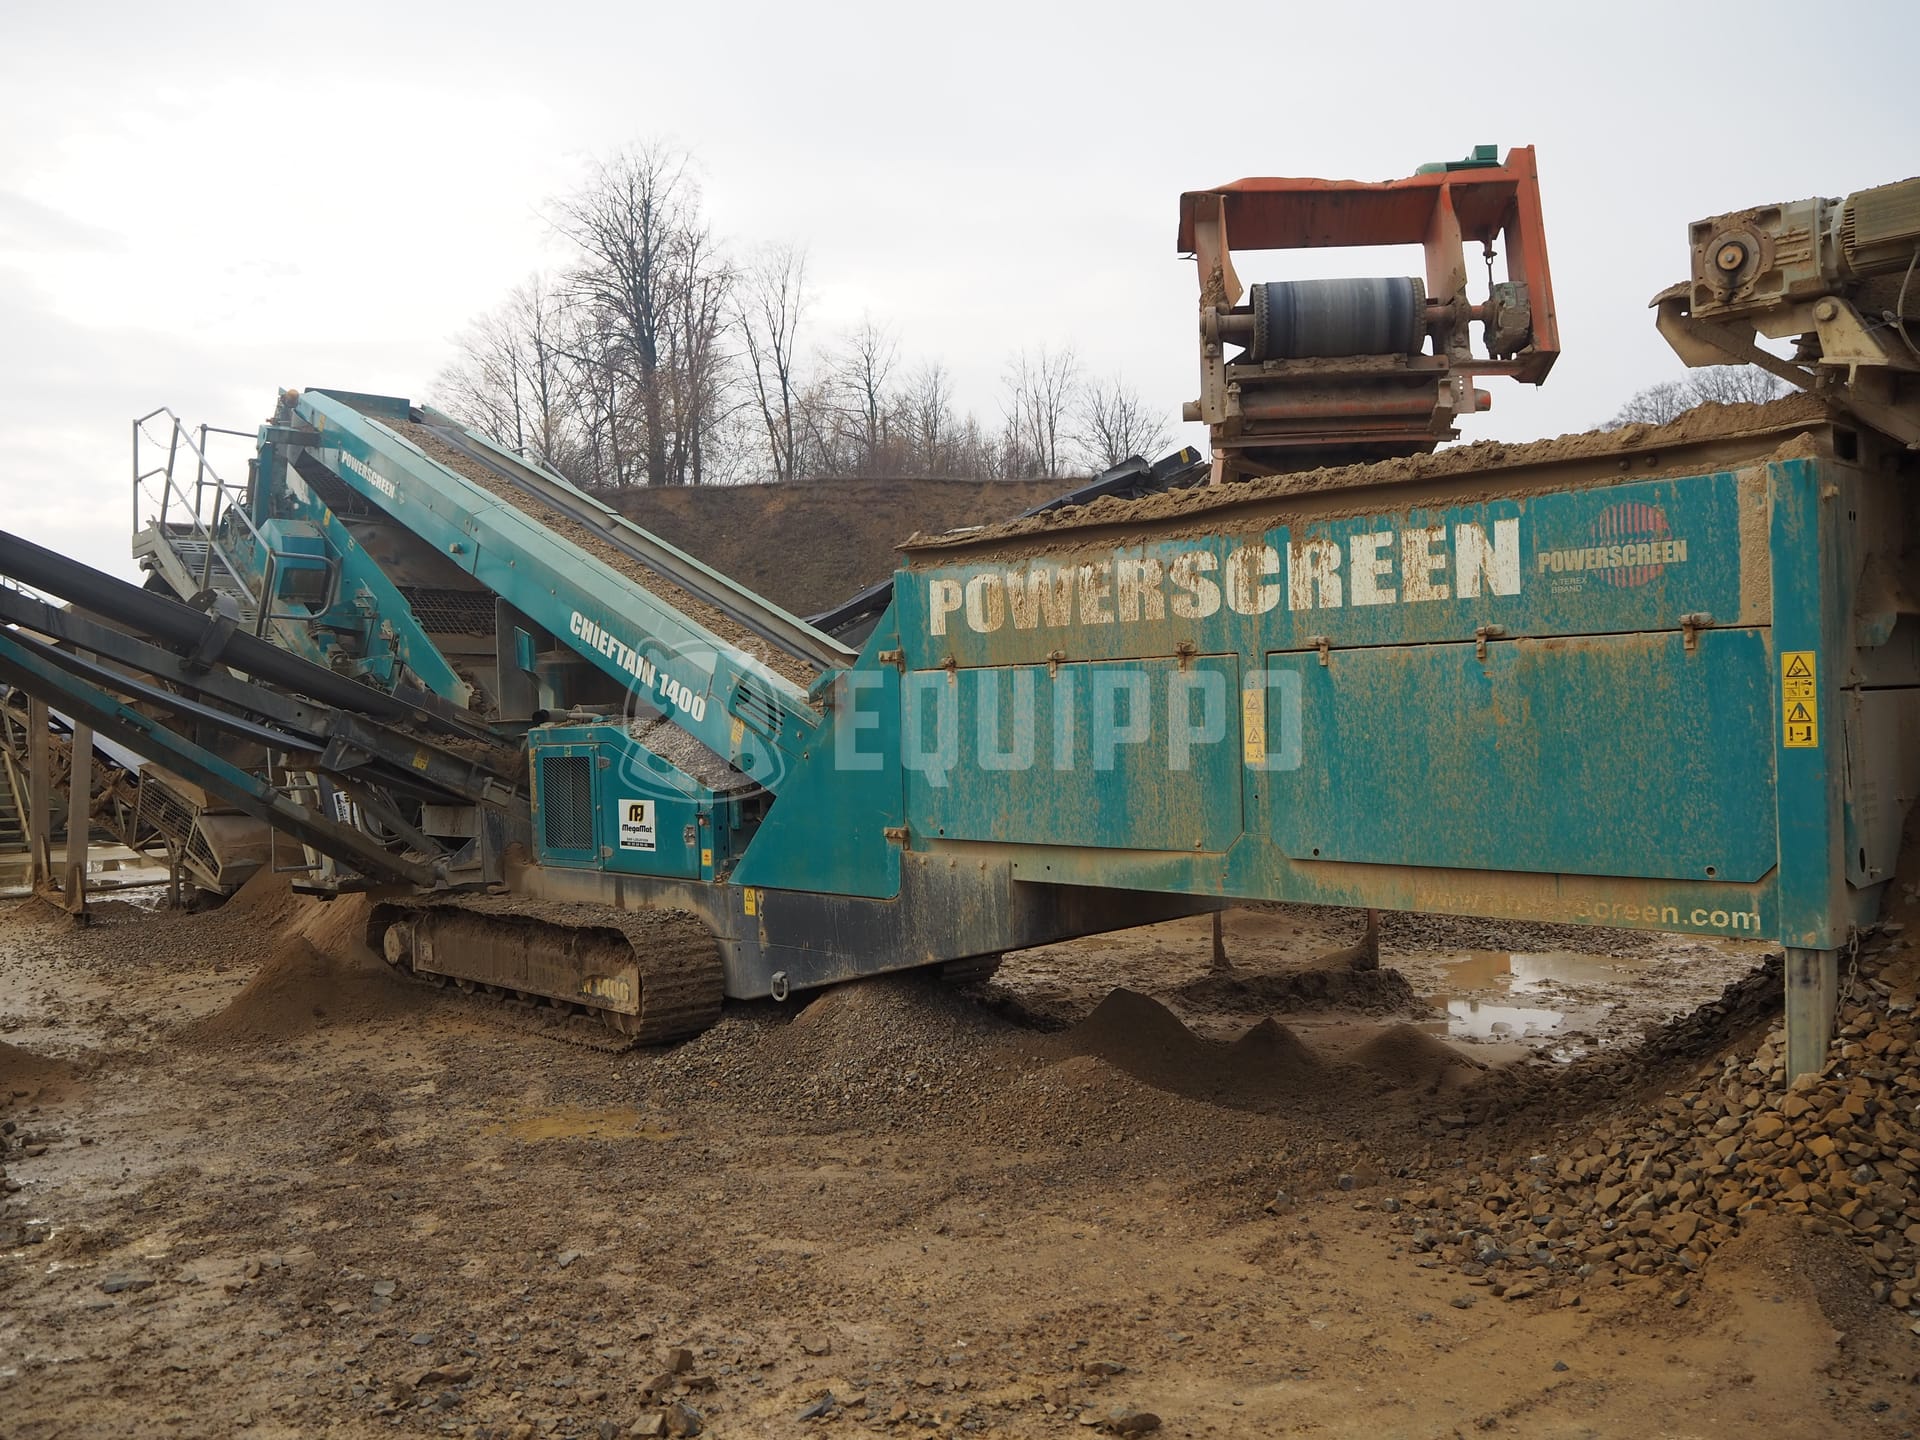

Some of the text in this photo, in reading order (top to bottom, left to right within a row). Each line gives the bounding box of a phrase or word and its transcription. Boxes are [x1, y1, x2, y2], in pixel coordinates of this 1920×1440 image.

[341, 450, 396, 500] POWERSCREEN
[1537, 539, 1688, 574] POWERSCREEN
[929, 517, 1522, 637] POWERSCREEN
[1551, 584, 1583, 594] BRAND
[1559, 576, 1588, 586] TEREX
[569, 611, 706, 722] CHIEFTAIN 1400
[621, 823, 653, 834] MegaMat
